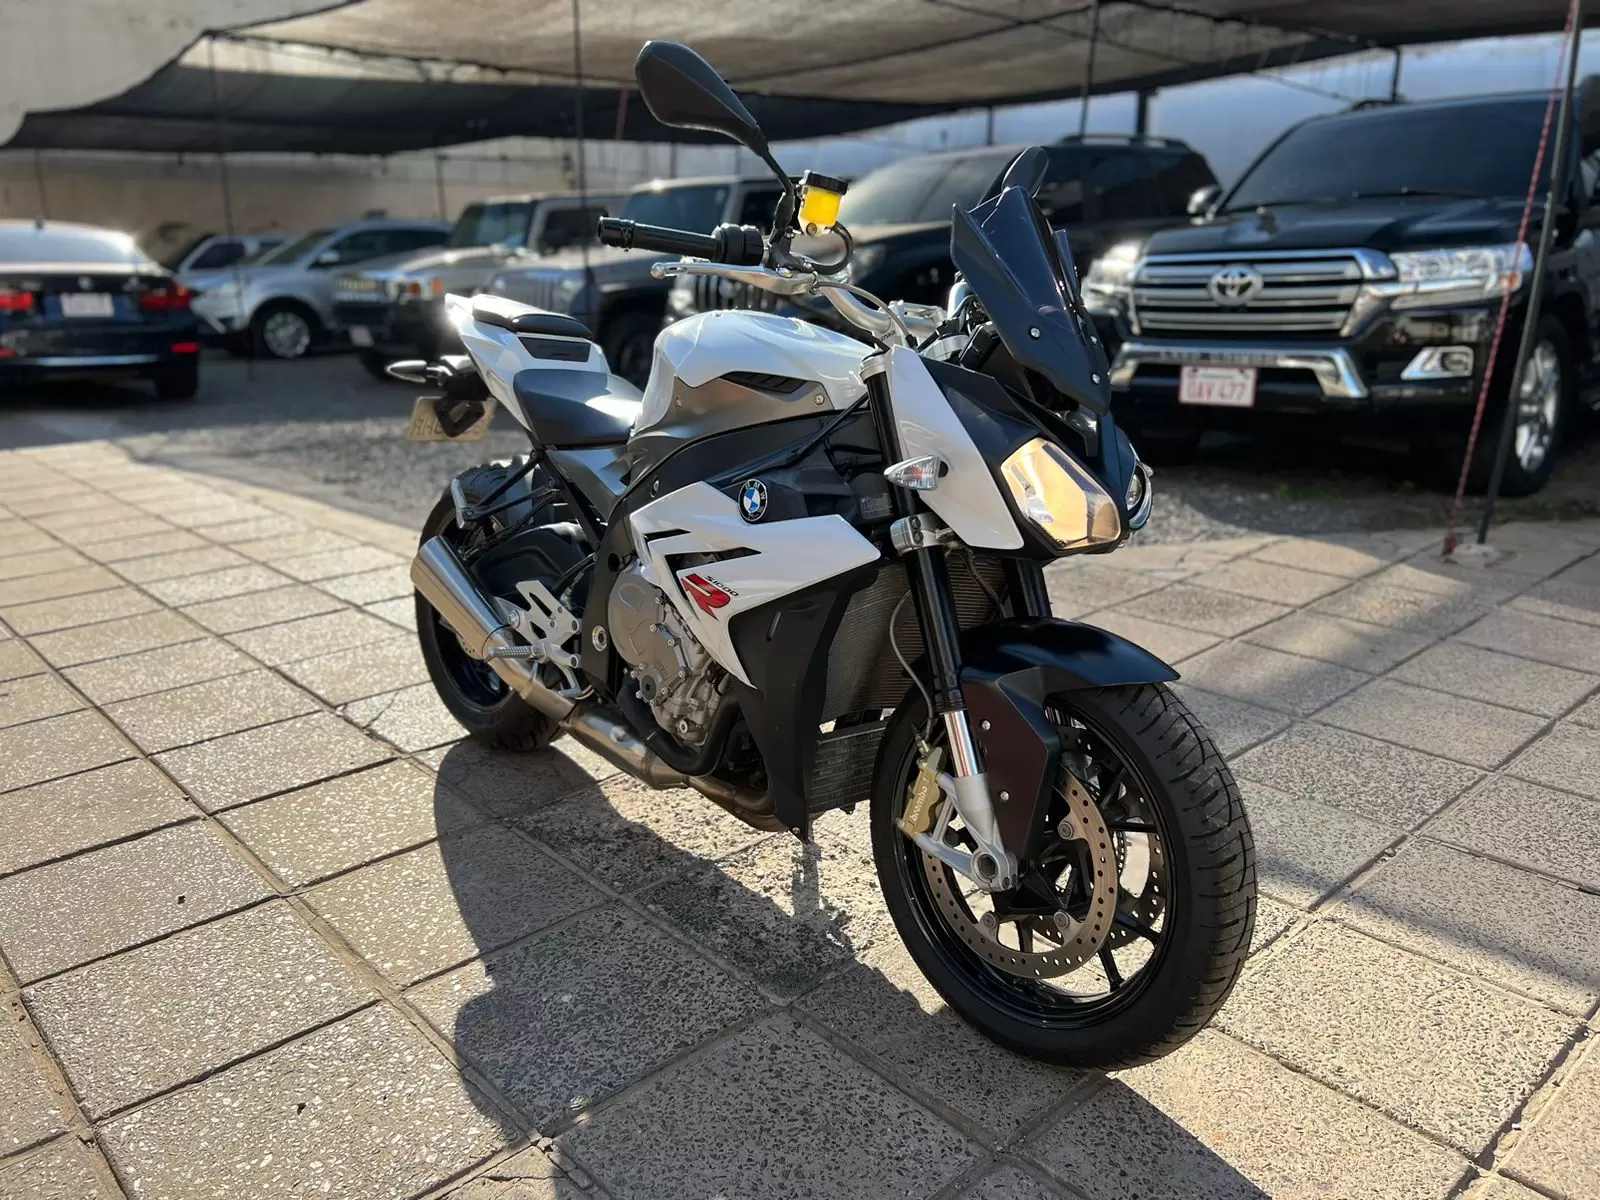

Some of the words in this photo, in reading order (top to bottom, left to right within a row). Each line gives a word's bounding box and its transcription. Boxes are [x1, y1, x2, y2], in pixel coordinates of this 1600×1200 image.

[680, 573, 731, 621] R
[705, 575, 739, 596] S1000
[909, 786, 928, 822] brembo
